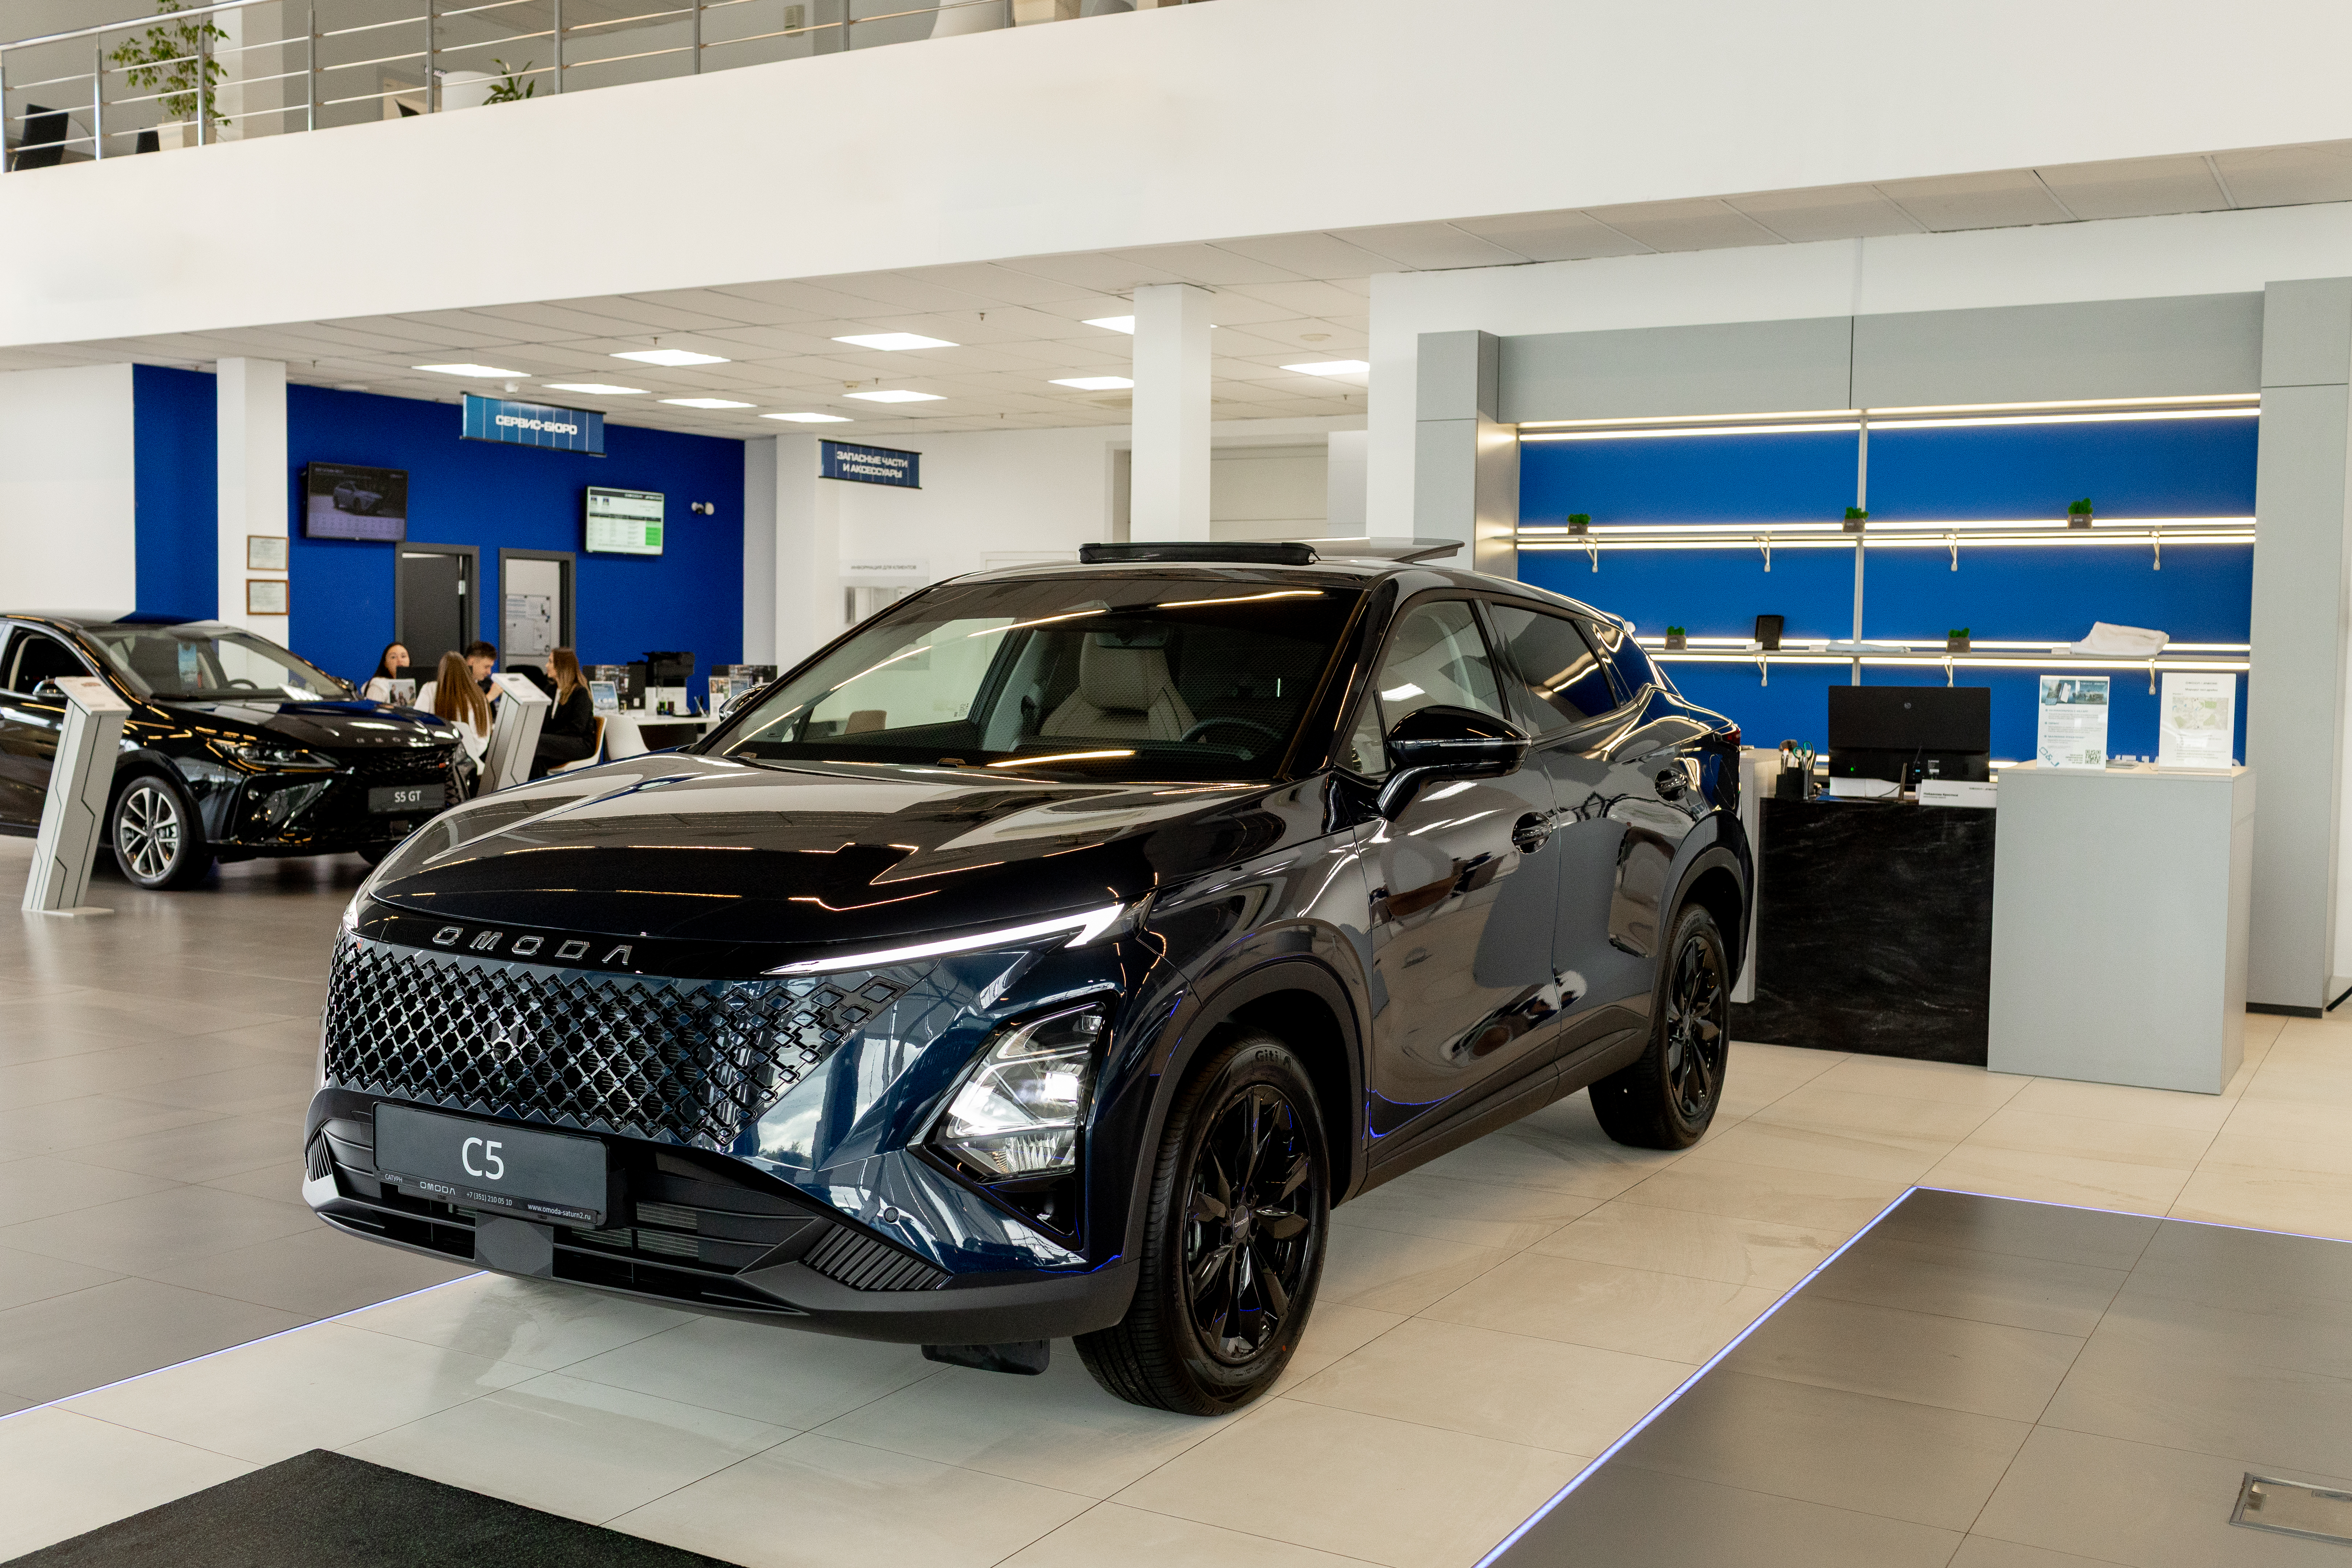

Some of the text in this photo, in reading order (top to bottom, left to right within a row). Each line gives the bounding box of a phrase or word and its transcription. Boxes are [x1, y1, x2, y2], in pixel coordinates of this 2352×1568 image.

[495, 414, 578, 435] СЕРВИС-БЮРО
[837, 450, 908, 468] ЗАПАСНЫЕ ЧАСТИ
[843, 463, 903, 478] И АКСЕССУАРЫ
[394, 790, 421, 803] S5 GT
[433, 926, 633, 965] OMODA
[1255, 1049, 1279, 1061] Giti
[462, 1137, 504, 1180] C5
[385, 1174, 402, 1183] САТУРН
[420, 1181, 456, 1195] OMODA
[474, 1192, 486, 1202] (351)
[527, 1204, 591, 1220] www.omoda-saturn2.ru
[1234, 1217, 1248, 1228] OMODA
